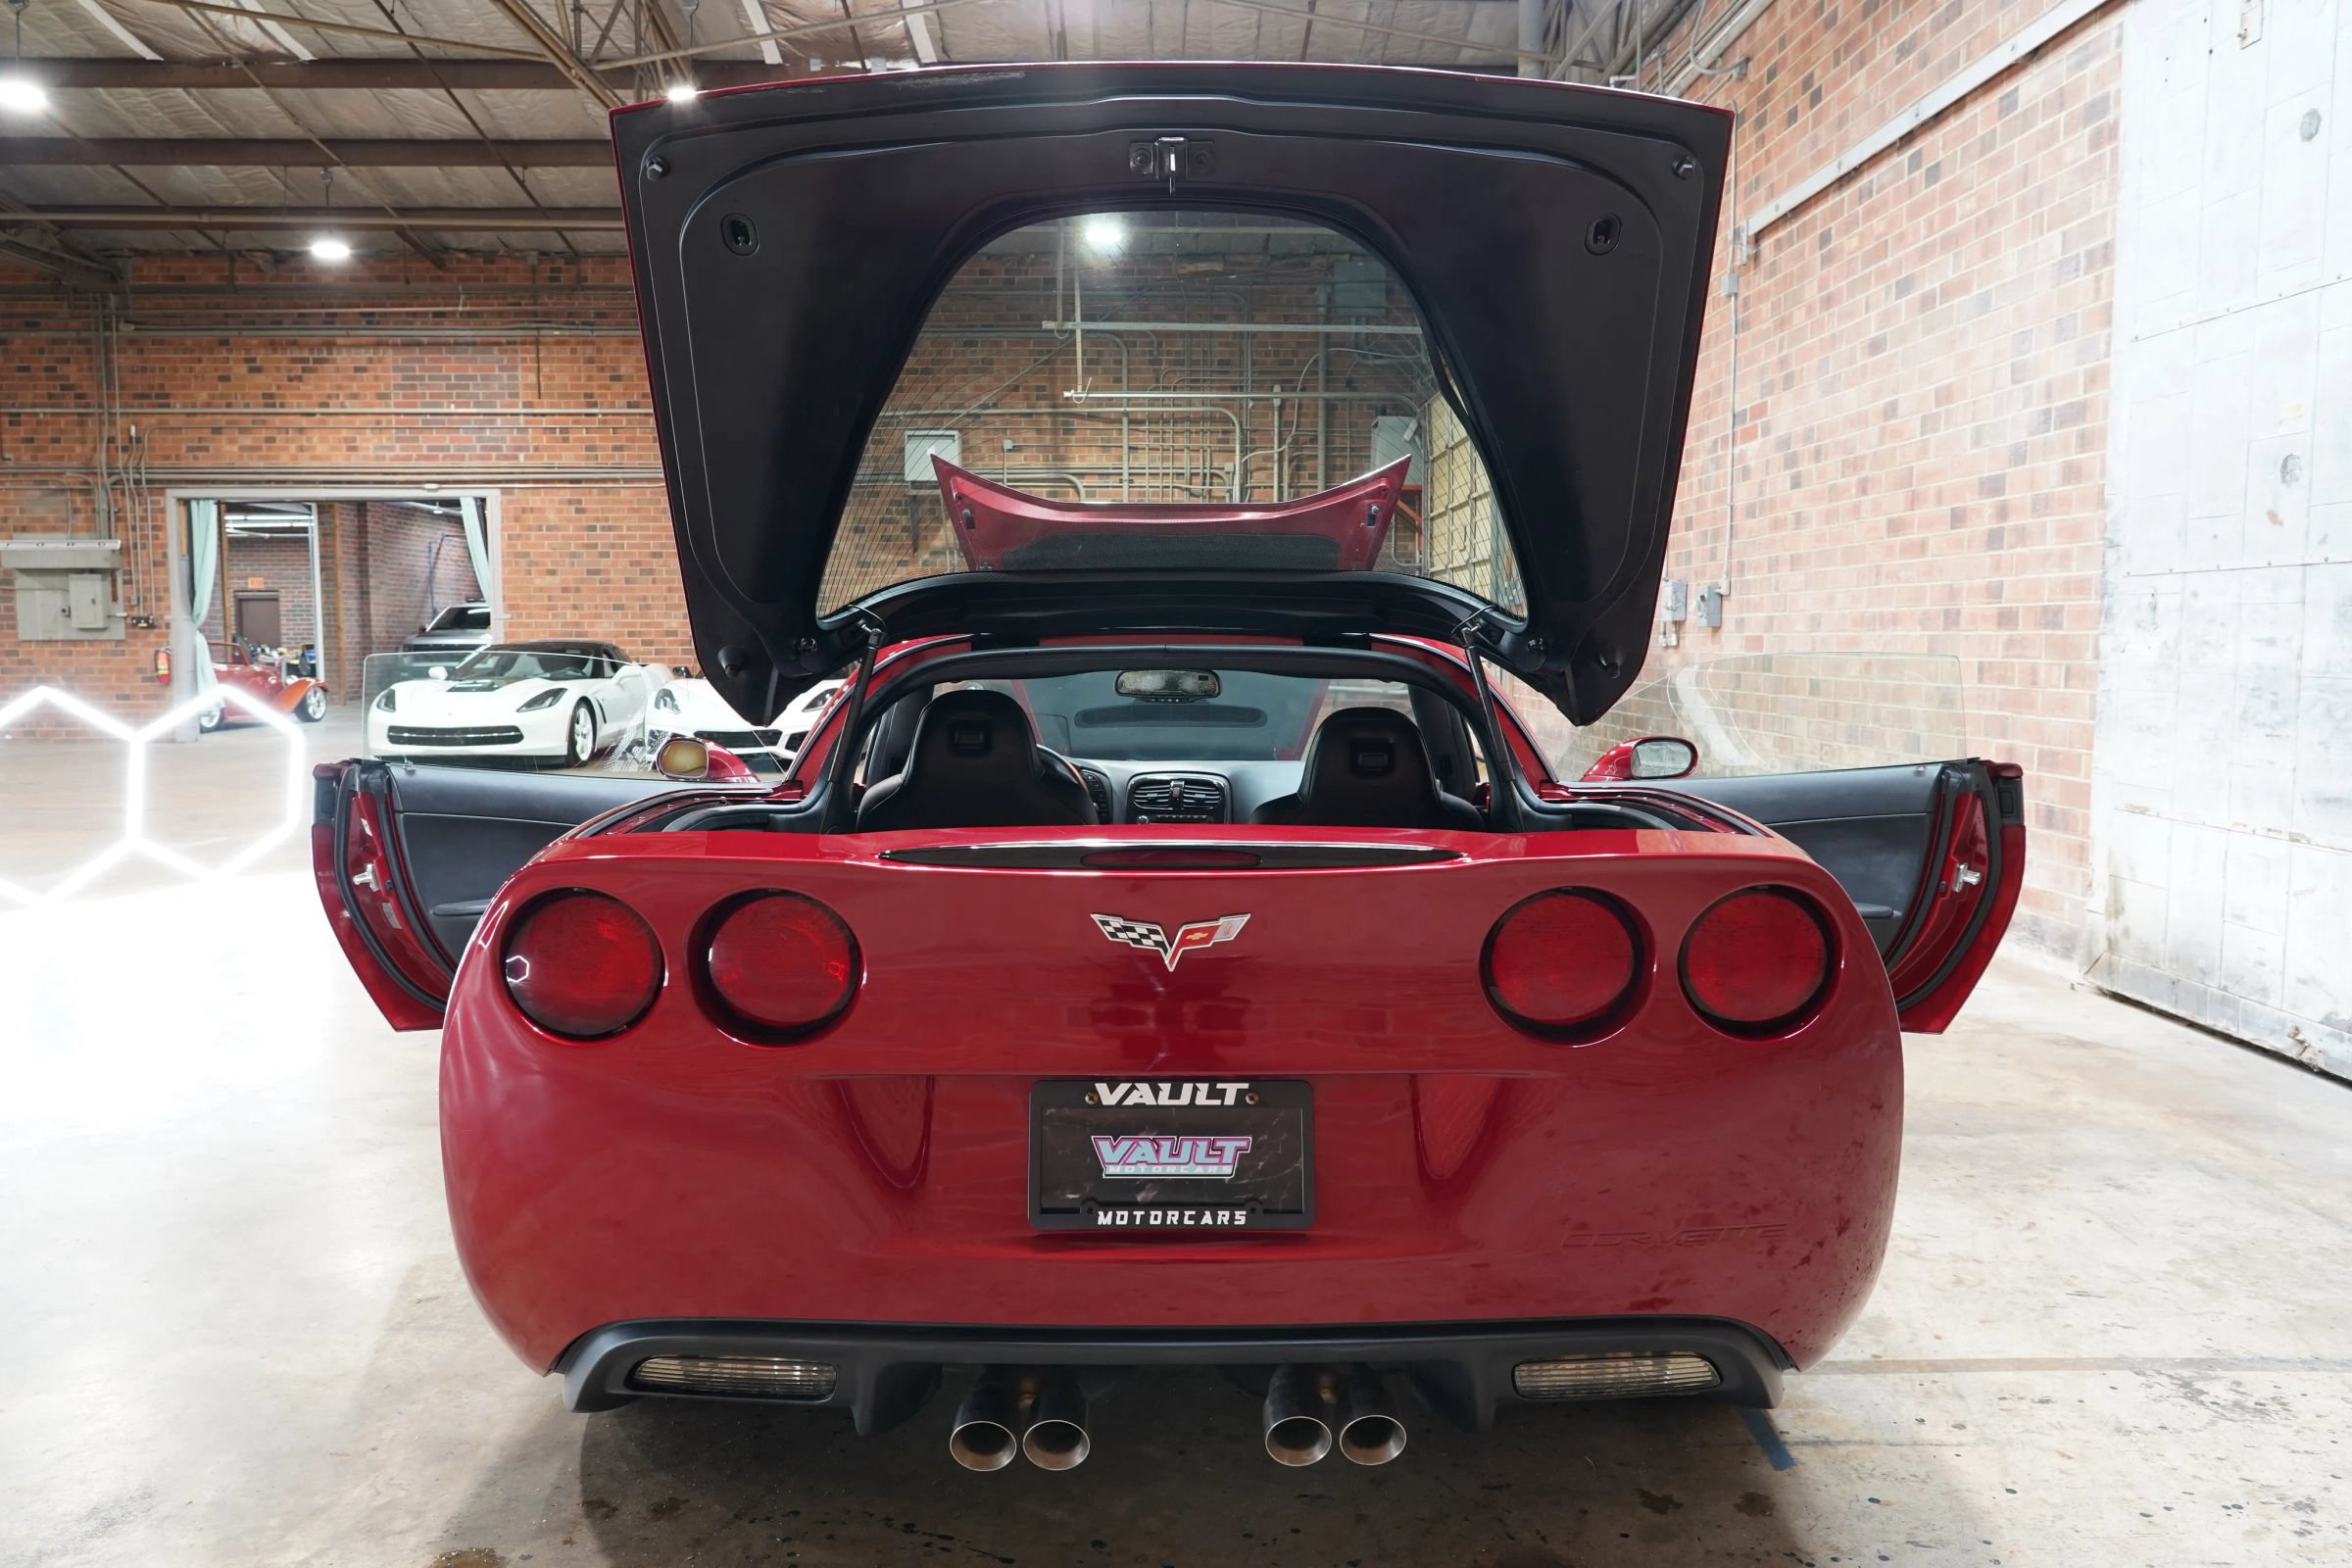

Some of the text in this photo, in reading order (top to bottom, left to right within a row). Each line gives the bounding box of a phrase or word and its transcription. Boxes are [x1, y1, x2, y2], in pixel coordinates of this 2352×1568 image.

[1094, 1082, 1250, 1105] VAULT
[1093, 1137, 1250, 1166] VAULT
[1107, 1164, 1234, 1174] MOTORCARS
[1097, 1210, 1248, 1226] MOTORCARS
[1560, 1222, 1788, 1248] CORVETTE
